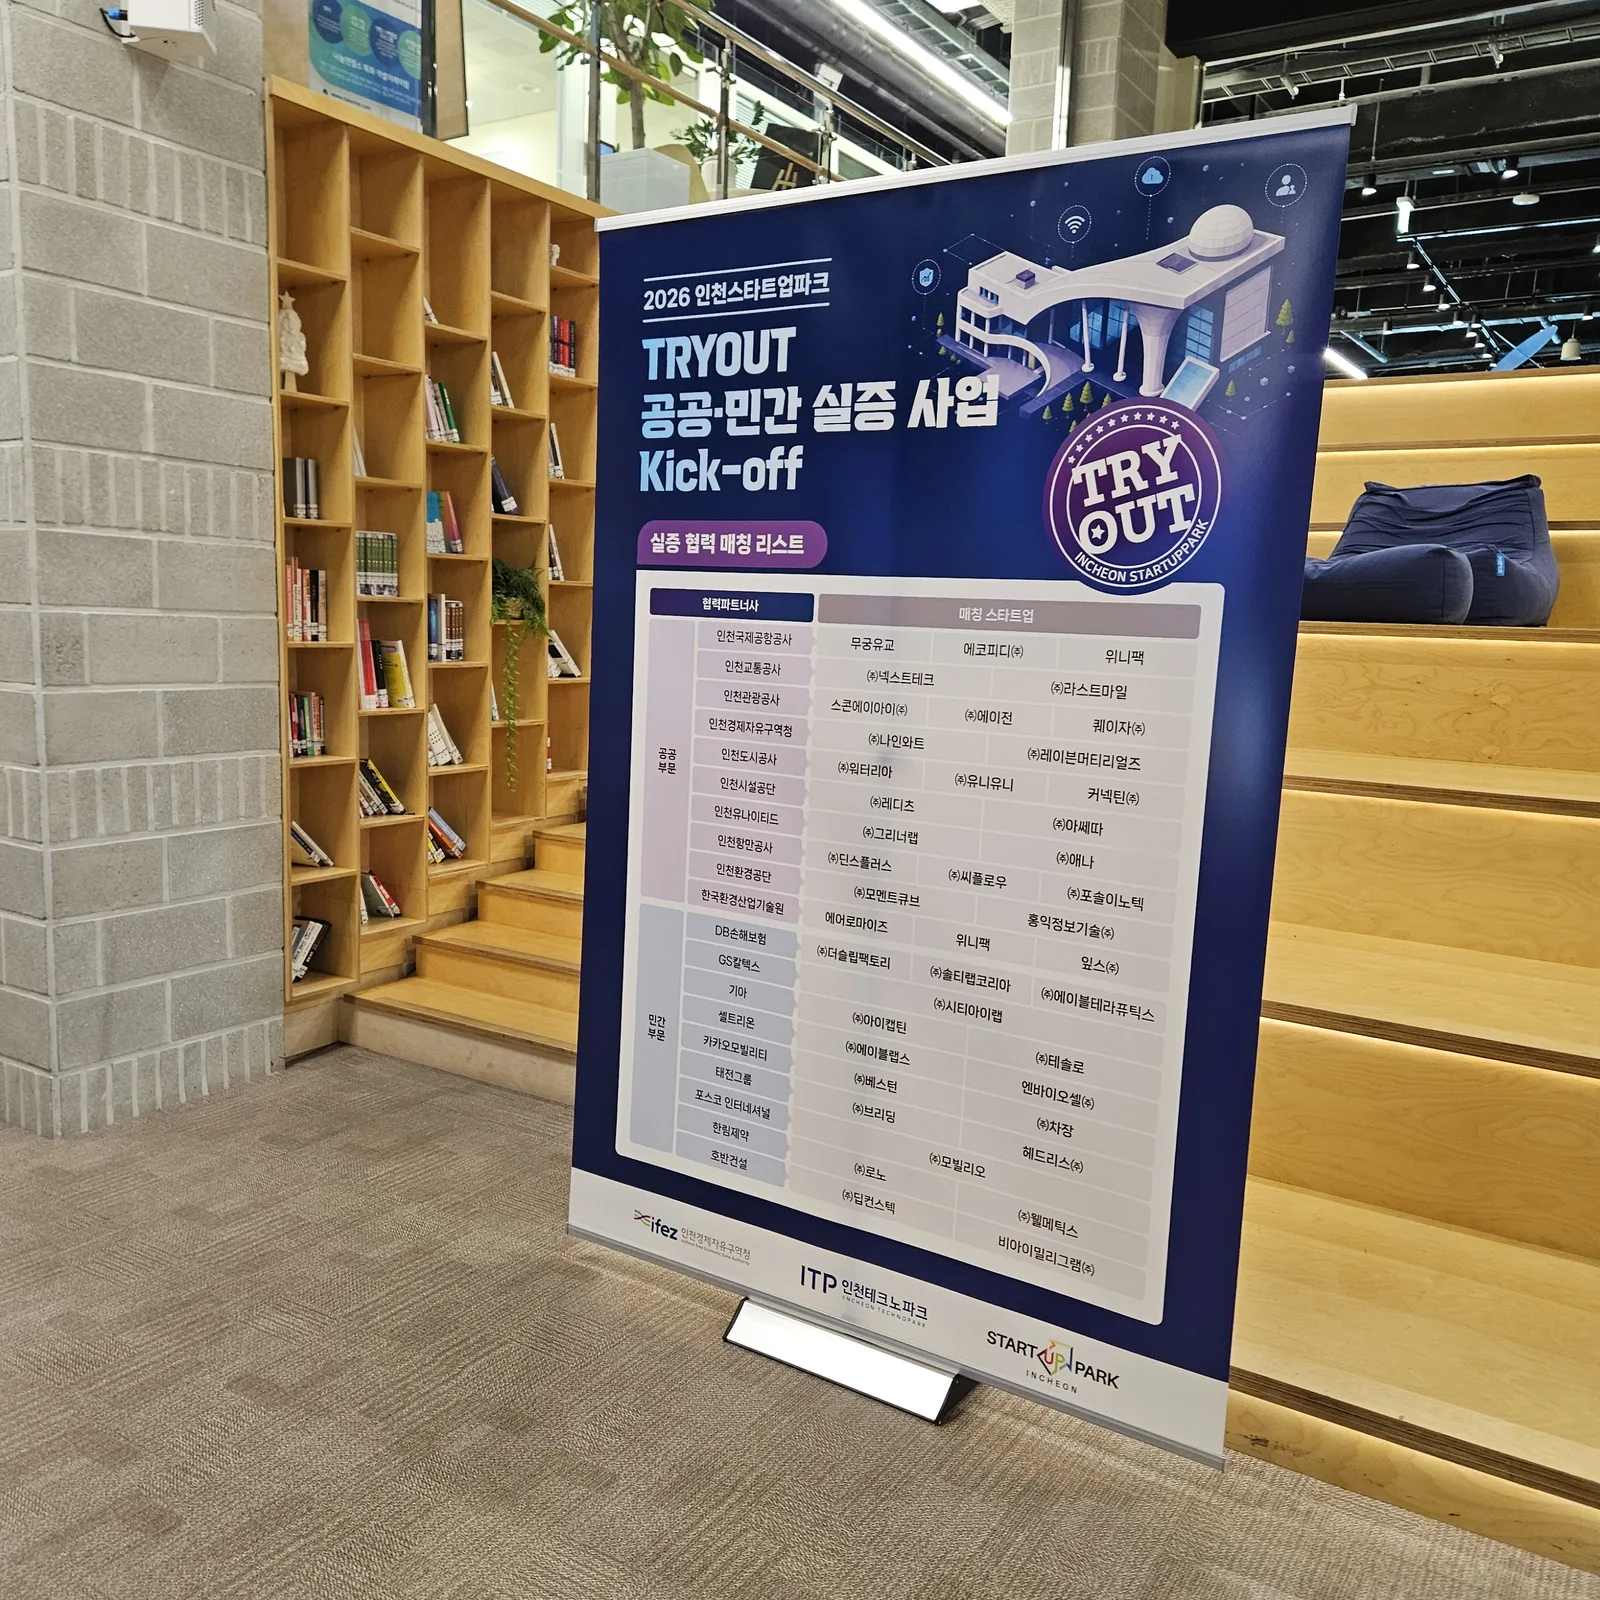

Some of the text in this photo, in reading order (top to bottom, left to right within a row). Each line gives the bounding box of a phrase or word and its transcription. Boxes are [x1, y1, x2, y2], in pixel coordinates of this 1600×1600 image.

[644, 272, 830, 311] 2026 인천스타트업파크
[641, 326, 797, 381] TRYOUT
[641, 374, 1000, 439] 공공·민간 실증 사업
[639, 445, 804, 492] Kick-off
[1071, 434, 1183, 507] TRY
[1078, 483, 1196, 555] OUT
[650, 532, 805, 555] 실증 협력 매칭 리스트
[1074, 518, 1209, 582] INCHEON STARTUPPARK
[702, 597, 759, 613] 협력파트너사
[959, 607, 1034, 624] 매칭 스타트업
[717, 630, 792, 646] 인천국제공항공사
[851, 637, 894, 651] 무궁유교
[1105, 649, 1144, 665] 위니팩
[725, 660, 781, 676] 인천교통공사
[724, 690, 780, 706] 인천관광공사
[709, 718, 792, 738] 인천경제자유구역청
[659, 748, 677, 760] 공공
[722, 748, 777, 766] 인천도시공사
[658, 762, 676, 774] 부문
[720, 777, 776, 796] 인천시설공단
[714, 806, 779, 825] 인천유나이티드
[718, 835, 773, 854] 인천항만공사
[716, 863, 772, 883] 인천환경공단
[701, 889, 784, 915] 한국환경산업기술원
[825, 912, 888, 933] 에어로마이즈
[715, 925, 766, 945] DB손해보험
[956, 934, 990, 951] 위니팩
[719, 954, 760, 972] GS칼텍스
[729, 985, 747, 999] 기아
[649, 1014, 666, 1030] 민간
[719, 1011, 755, 1029] 셀트리온
[648, 1026, 665, 1041] 부문
[704, 1035, 767, 1061] 카카오모빌리티
[716, 1067, 752, 1086] 태전그룹
[695, 1089, 770, 1120] 포스코 인터네셔널
[713, 1122, 749, 1142] 한림제약
[711, 1150, 747, 1171] 호반건설
[650, 1216, 679, 1241] ifez
[681, 1227, 751, 1260] 인천경제자유구역청
[800, 1264, 837, 1294] ITP
[841, 1279, 928, 1321] 인천테크노파크
[986, 1330, 1039, 1359] START
[1074, 1361, 1120, 1390] PARK
[1026, 1369, 1077, 1394] INCHEON
